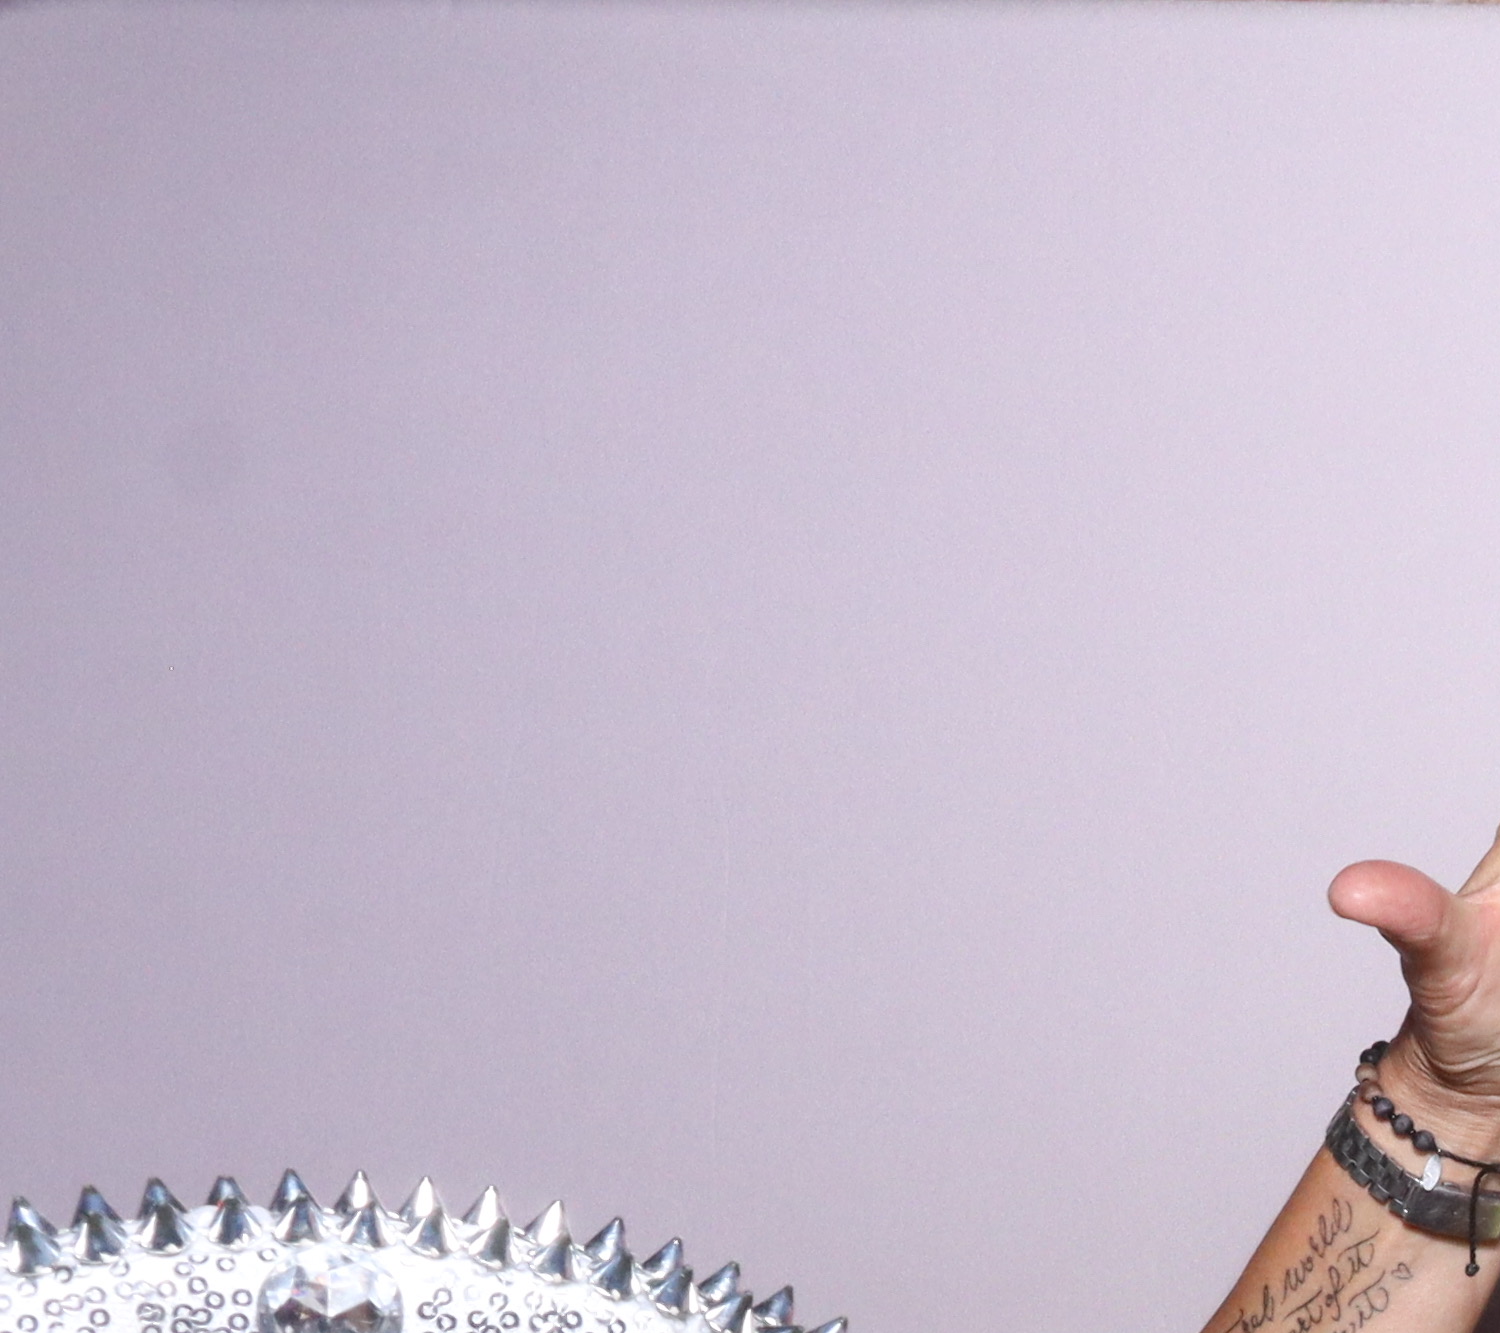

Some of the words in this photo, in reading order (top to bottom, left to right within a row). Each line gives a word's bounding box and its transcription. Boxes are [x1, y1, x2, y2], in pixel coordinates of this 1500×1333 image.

[1281, 1198, 1352, 1305] world
[1324, 1265, 1345, 1322] of
[1337, 1228, 1380, 1283] it
[1347, 1269, 1389, 1328] it
